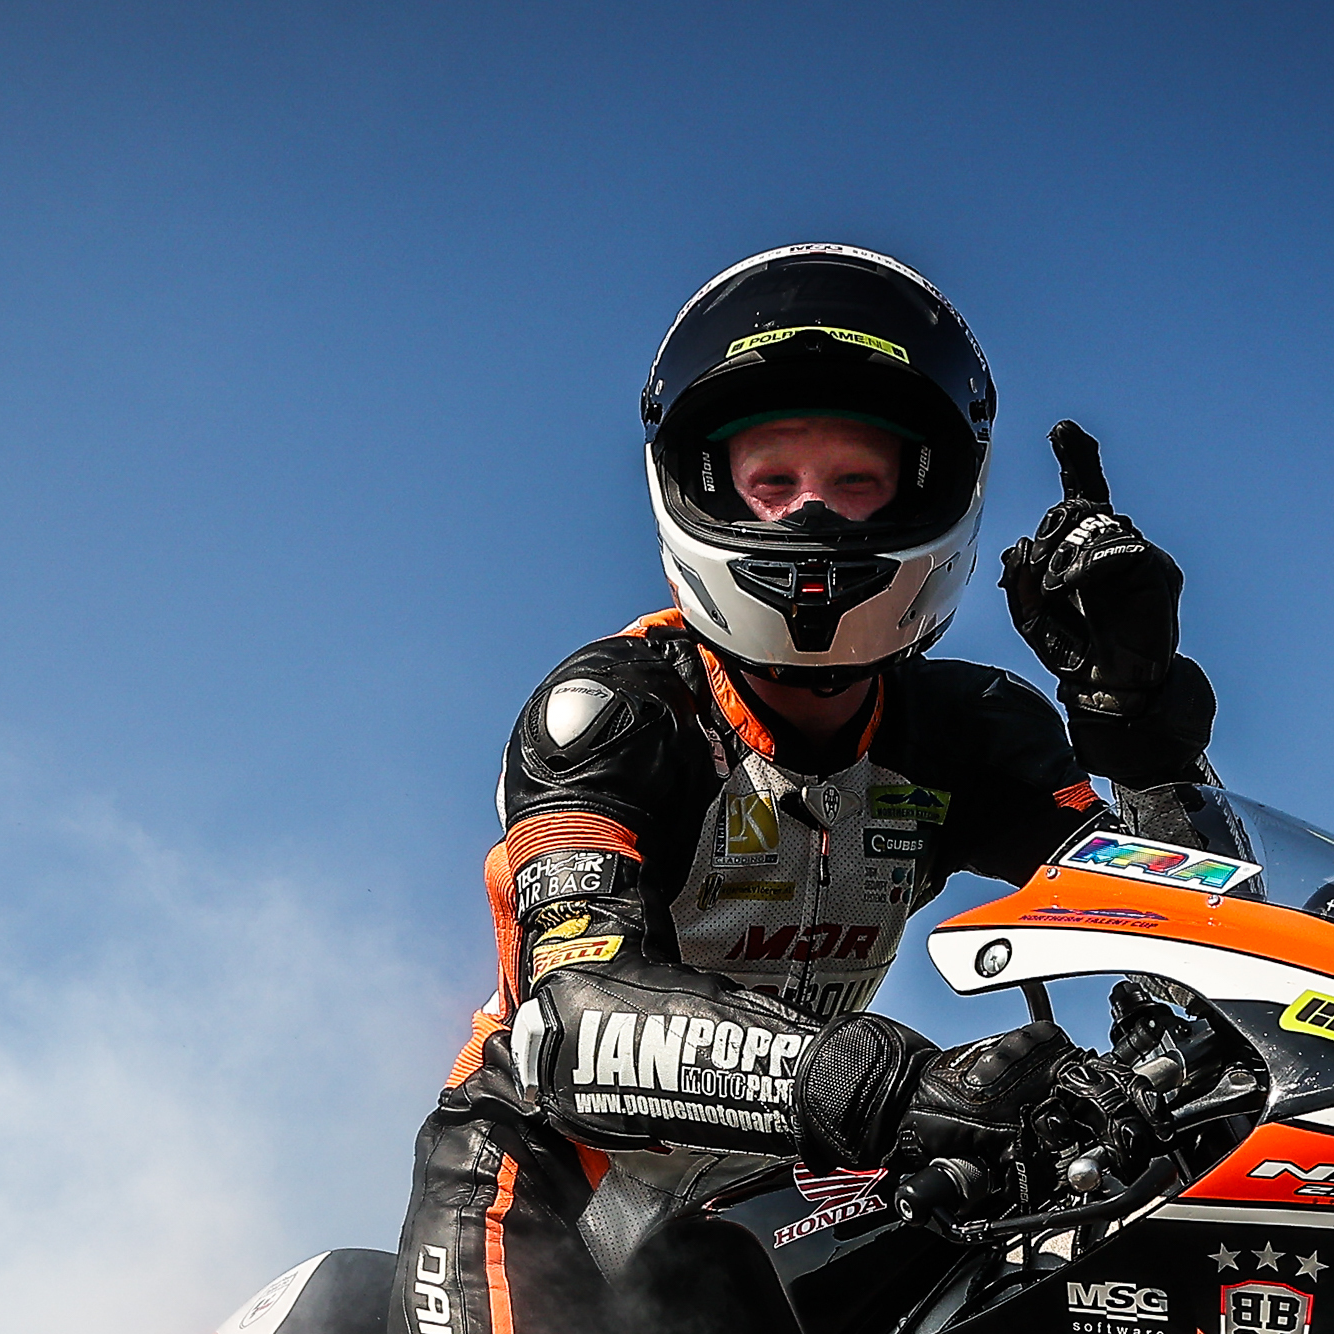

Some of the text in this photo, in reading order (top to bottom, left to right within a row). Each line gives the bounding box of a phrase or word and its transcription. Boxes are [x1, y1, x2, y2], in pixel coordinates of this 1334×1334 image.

[917, 445, 931, 488] NOLAN
[1092, 545, 1145, 562] DAMEN
[518, 881, 542, 918] AIR
[547, 873, 601, 897] BAG
[1130, 920, 1159, 929] CUP
[572, 1009, 815, 1093] JAN POPP
[774, 1195, 887, 1249] HONDA
[1067, 1281, 1168, 1314] MSG
